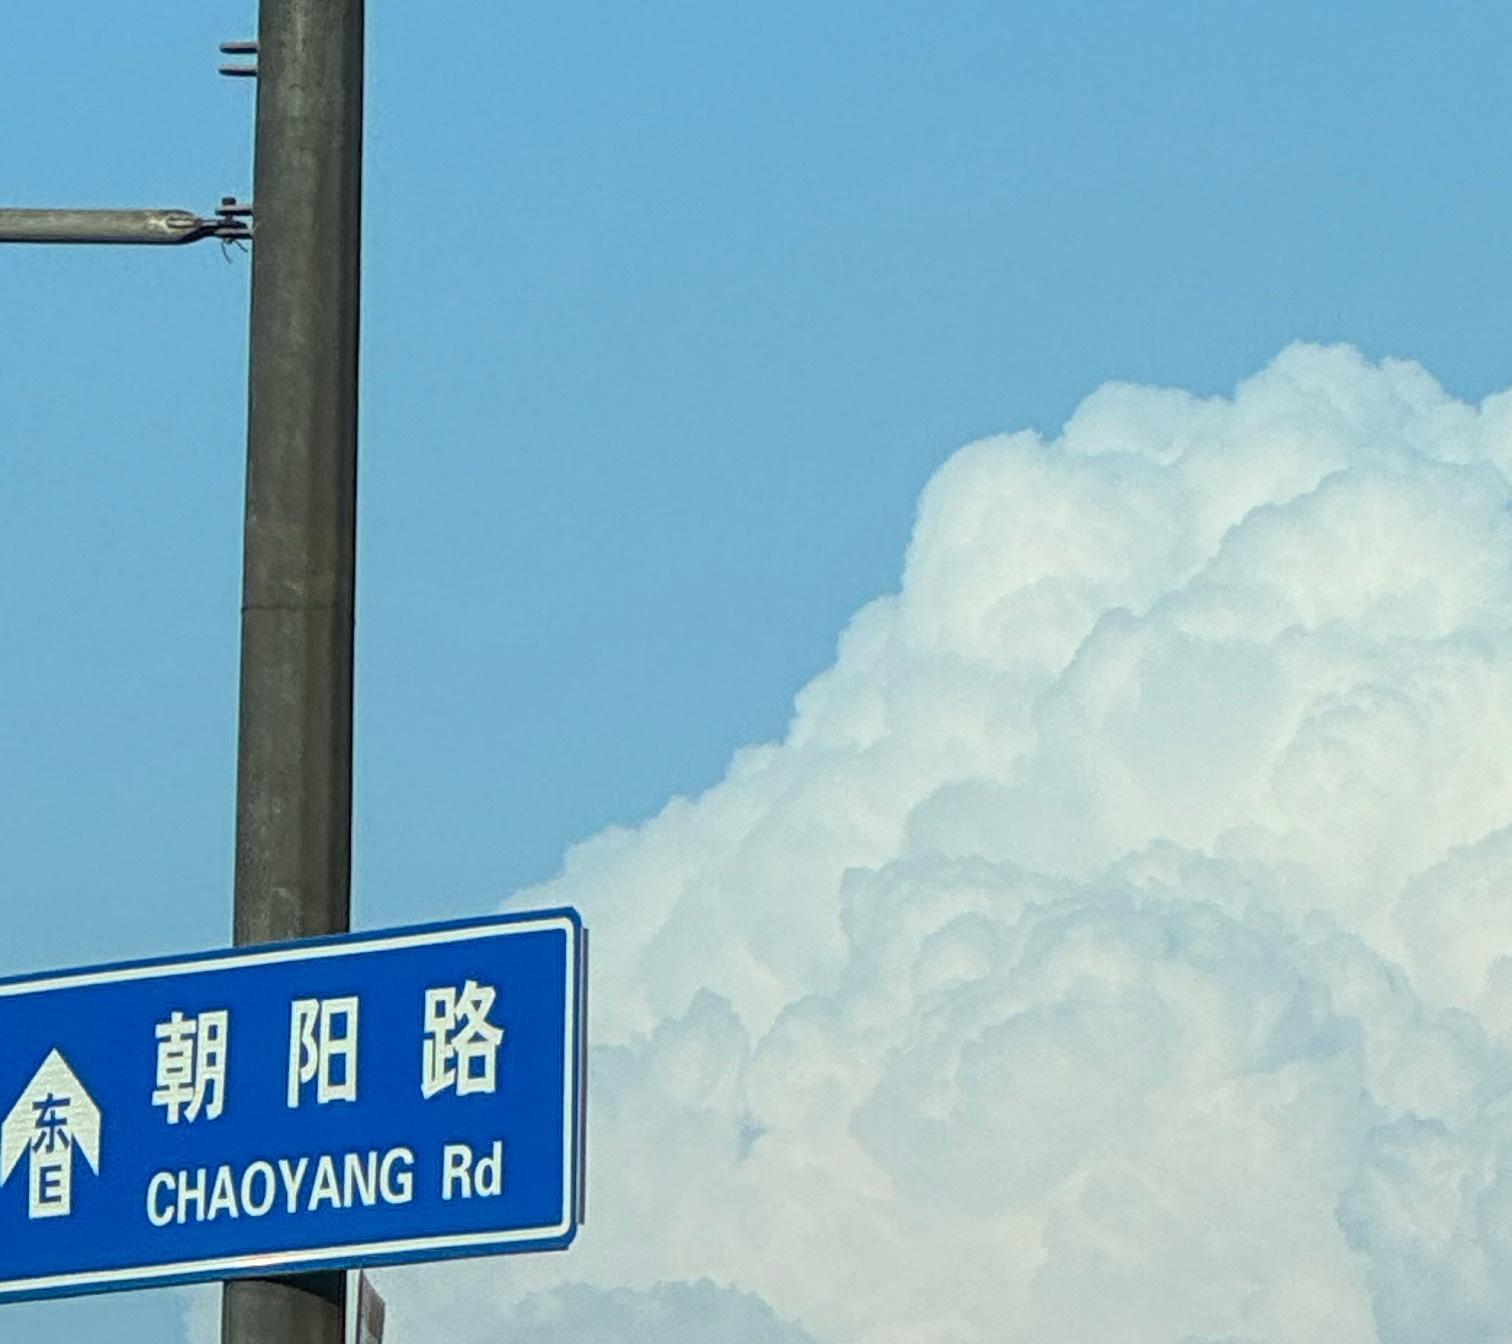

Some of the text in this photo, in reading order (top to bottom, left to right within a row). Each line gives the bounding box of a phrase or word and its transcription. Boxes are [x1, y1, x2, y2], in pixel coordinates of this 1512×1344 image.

[152, 980, 504, 1124] 朝阳路
[32, 1093, 71, 1152] 东
[39, 1165, 62, 1204] E
[147, 1141, 503, 1226] CHAOYANG Rd
